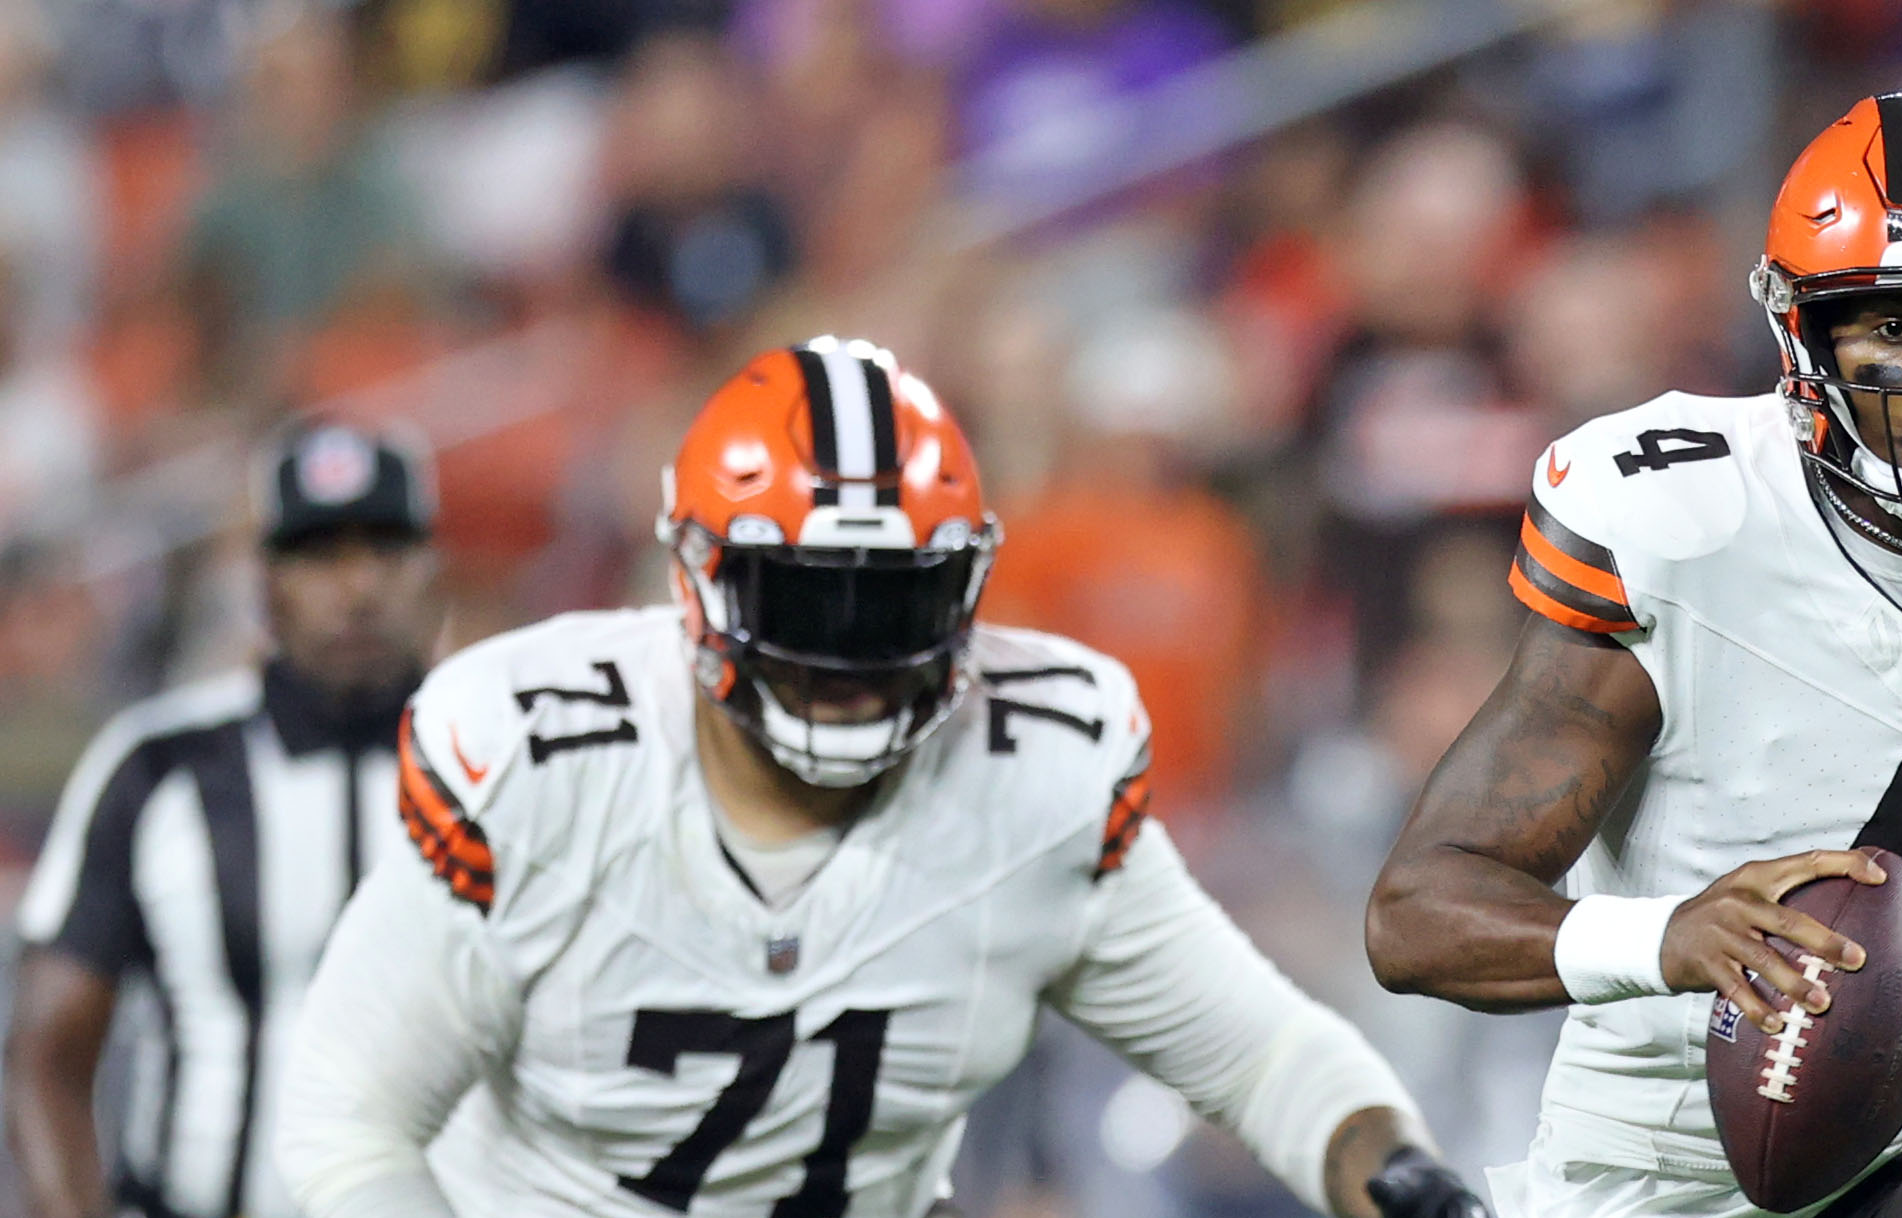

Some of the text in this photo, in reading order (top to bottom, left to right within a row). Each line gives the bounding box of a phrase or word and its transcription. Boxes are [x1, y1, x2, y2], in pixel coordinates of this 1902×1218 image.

[1612, 427, 1731, 478] 4
[514, 660, 639, 765] 71
[981, 667, 1105, 754] 71
